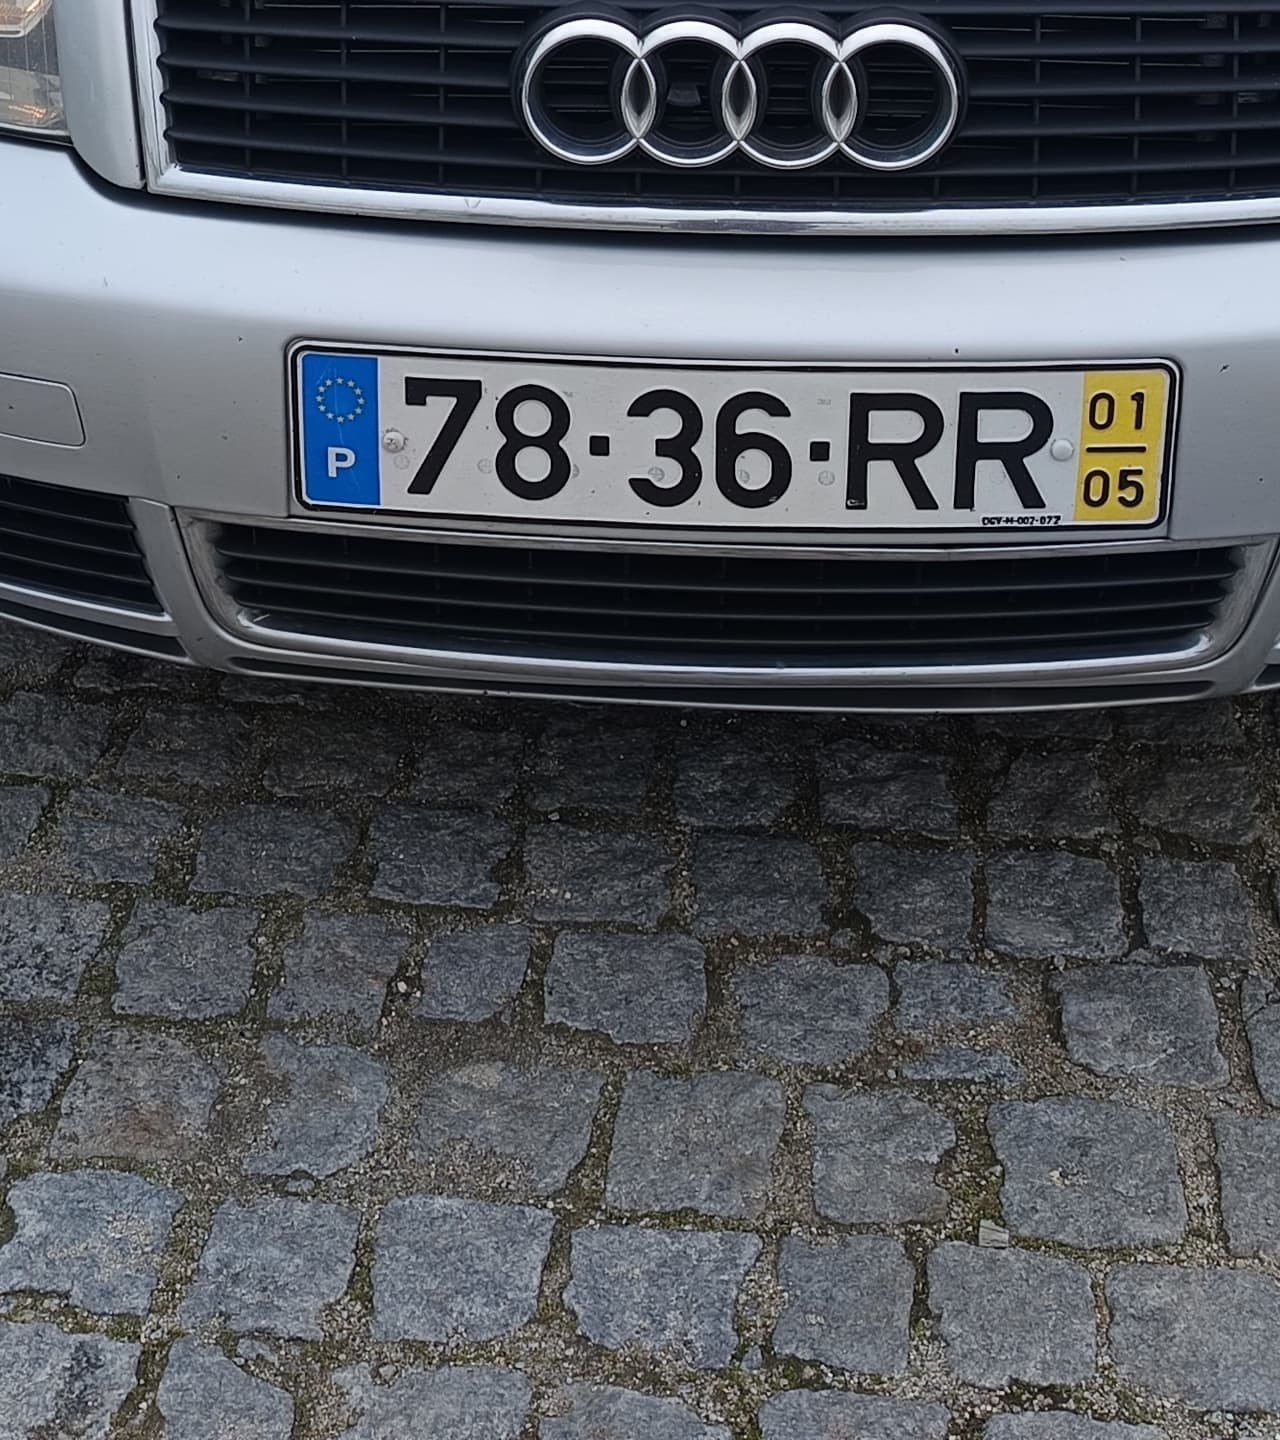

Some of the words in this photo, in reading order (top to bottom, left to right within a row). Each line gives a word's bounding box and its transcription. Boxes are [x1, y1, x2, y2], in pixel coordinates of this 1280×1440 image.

[1088, 391, 1146, 431] 01
[326, 445, 356, 478] P
[1082, 468, 1145, 509] 05
